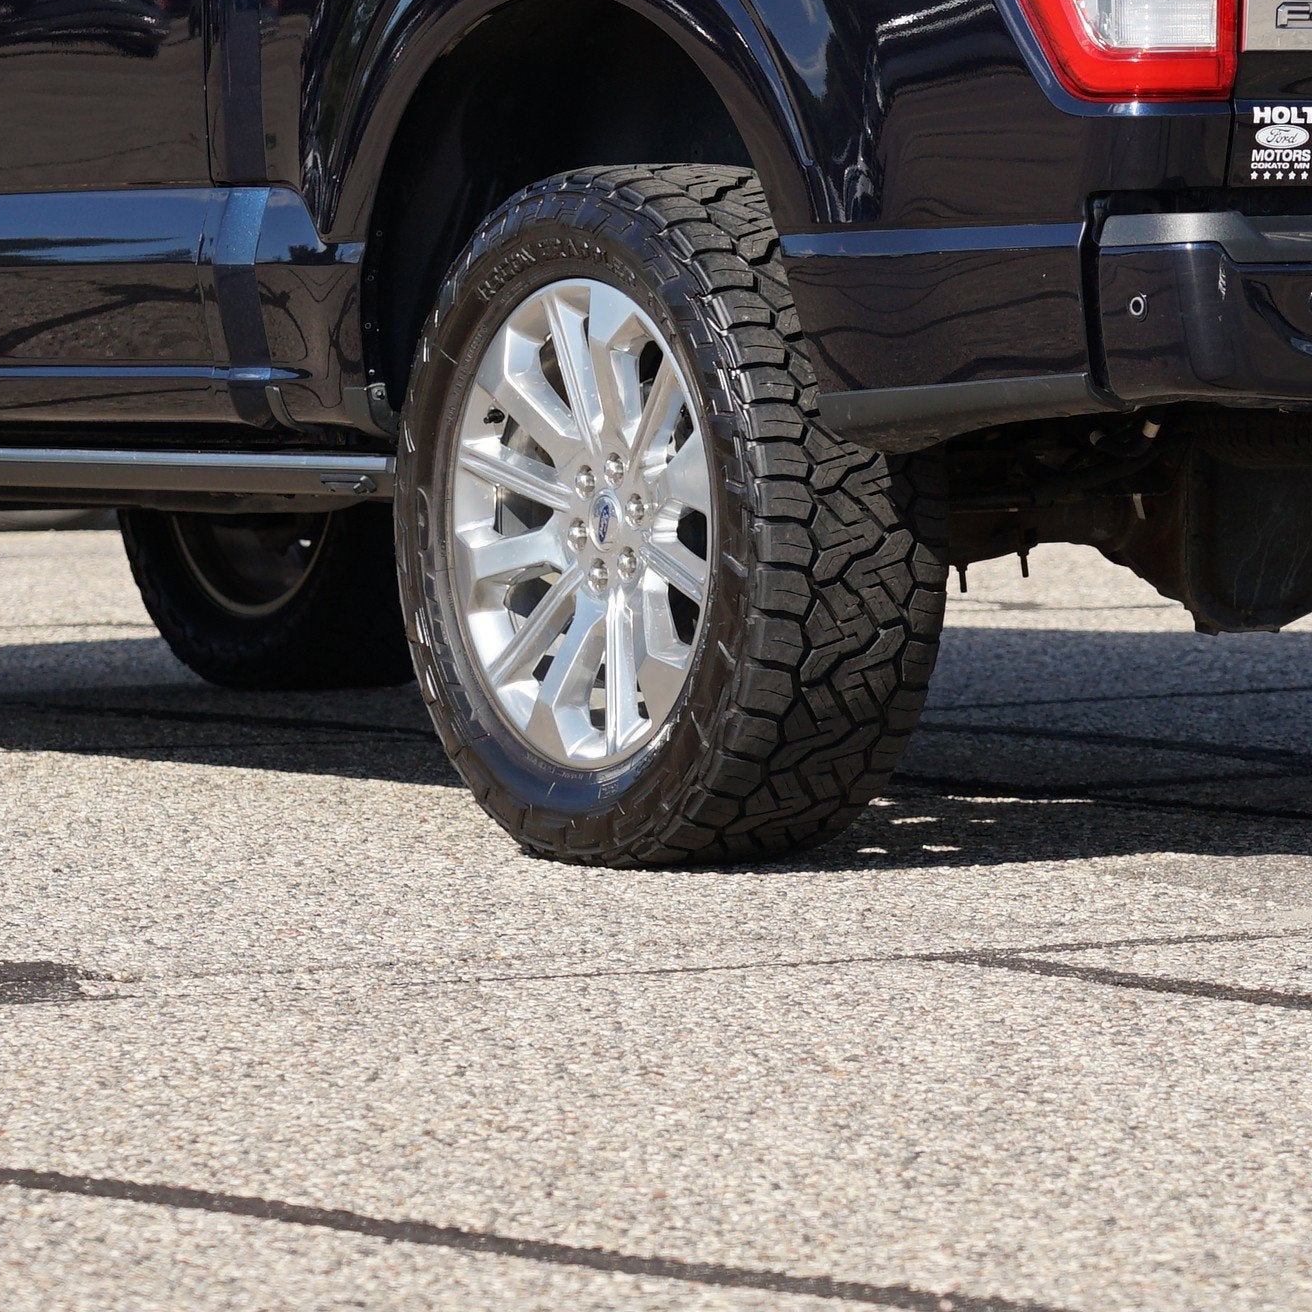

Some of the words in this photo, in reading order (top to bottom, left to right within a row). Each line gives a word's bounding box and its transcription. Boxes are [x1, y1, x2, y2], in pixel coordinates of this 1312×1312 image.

[1265, 128, 1299, 144] Ford
[1251, 149, 1312, 162] MOTORS
[1250, 162, 1290, 170] COKATO
[1293, 162, 1310, 170] MN
